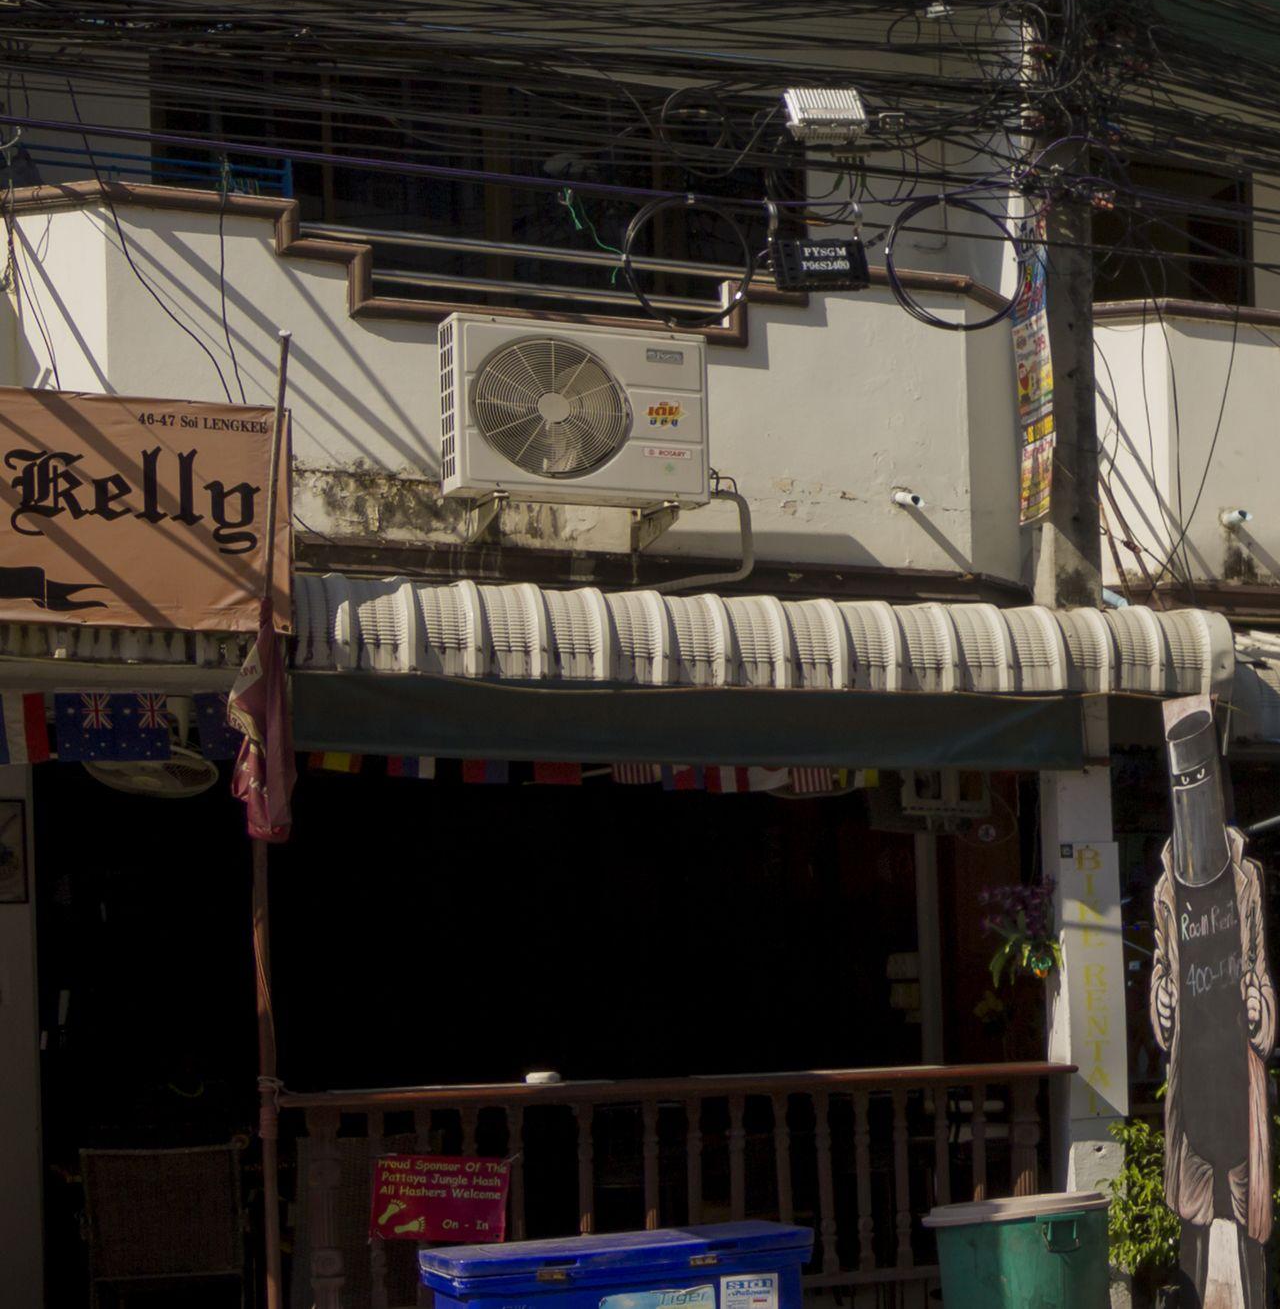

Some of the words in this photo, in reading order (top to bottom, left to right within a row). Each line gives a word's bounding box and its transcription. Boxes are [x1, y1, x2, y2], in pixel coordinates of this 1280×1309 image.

[138, 412, 176, 427] 46-47
[180, 415, 199, 429] Soi
[203, 417, 268, 434] LENGKEE
[4, 446, 262, 555] Kelly
[1083, 963, 1111, 1116] RENTAL
[416, 1160, 460, 1172] Sponsor
[465, 1162, 480, 1172] Of
[486, 1163, 507, 1174] The
[382, 1172, 426, 1184] Pattaya
[431, 1173, 468, 1187] Jungle
[473, 1176, 501, 1187] Hash
[380, 1185, 395, 1195] All
[399, 1187, 446, 1198] Hashers
[452, 1188, 502, 1200] Welcome
[442, 1219, 459, 1229] On
[476, 1220, 489, 1230] In
[660, 1292, 709, 1305] Tiger
